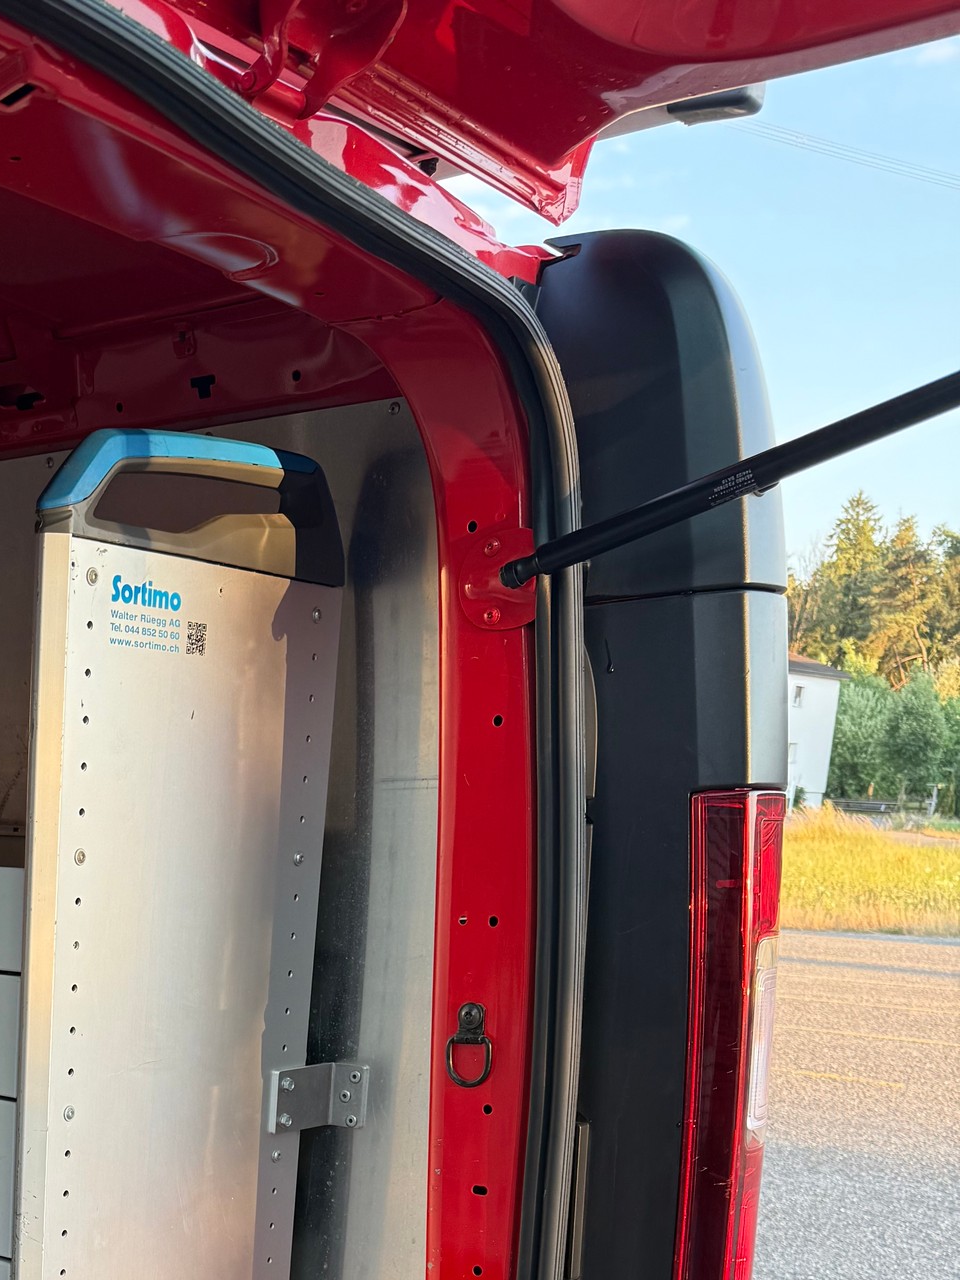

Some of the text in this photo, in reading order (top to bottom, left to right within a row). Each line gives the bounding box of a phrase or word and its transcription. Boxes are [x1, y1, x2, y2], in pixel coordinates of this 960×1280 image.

[111, 574, 182, 612] Sortimo
[110, 609, 181, 628] Walter Rüegg AG
[110, 622, 180, 640] Tel. 044 852 50 60
[109, 637, 180, 653] www.sortimo.ch
